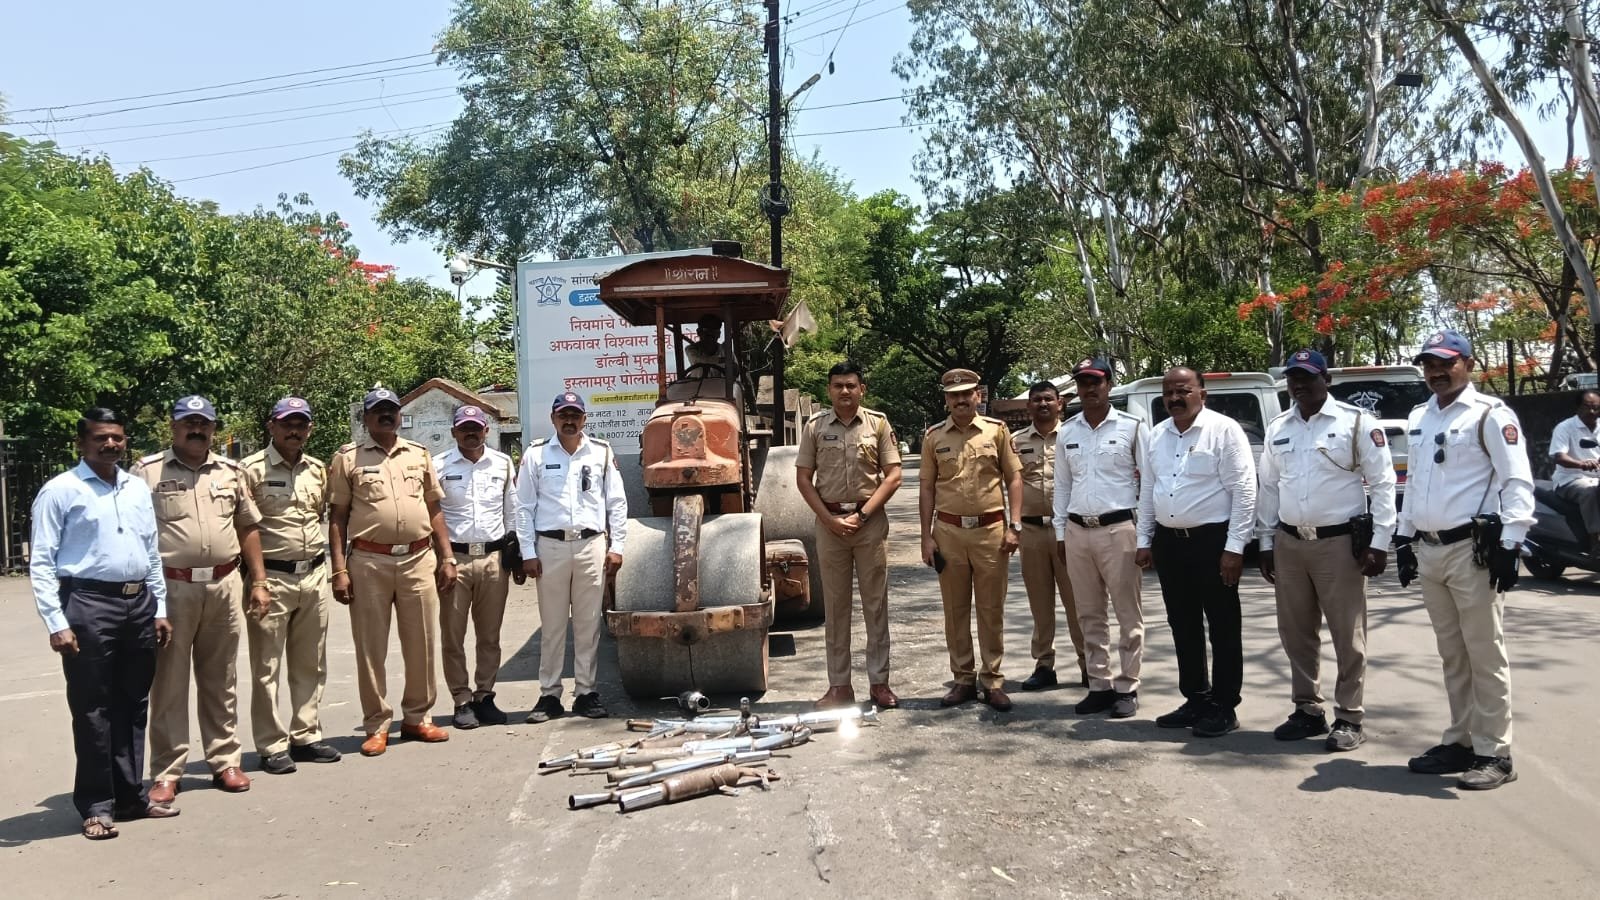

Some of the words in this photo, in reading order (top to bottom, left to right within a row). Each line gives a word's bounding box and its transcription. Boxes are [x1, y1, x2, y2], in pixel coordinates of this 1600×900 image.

[570, 314, 615, 332] नियमांचे
[549, 334, 600, 352] अफवांवर
[604, 333, 649, 349] विश्वास
[594, 351, 629, 369] डॉल्बी
[564, 375, 616, 392] इस्लामपूर
[595, 410, 611, 418] मदत
[616, 409, 626, 417] 112
[606, 431, 624, 440] 8007
